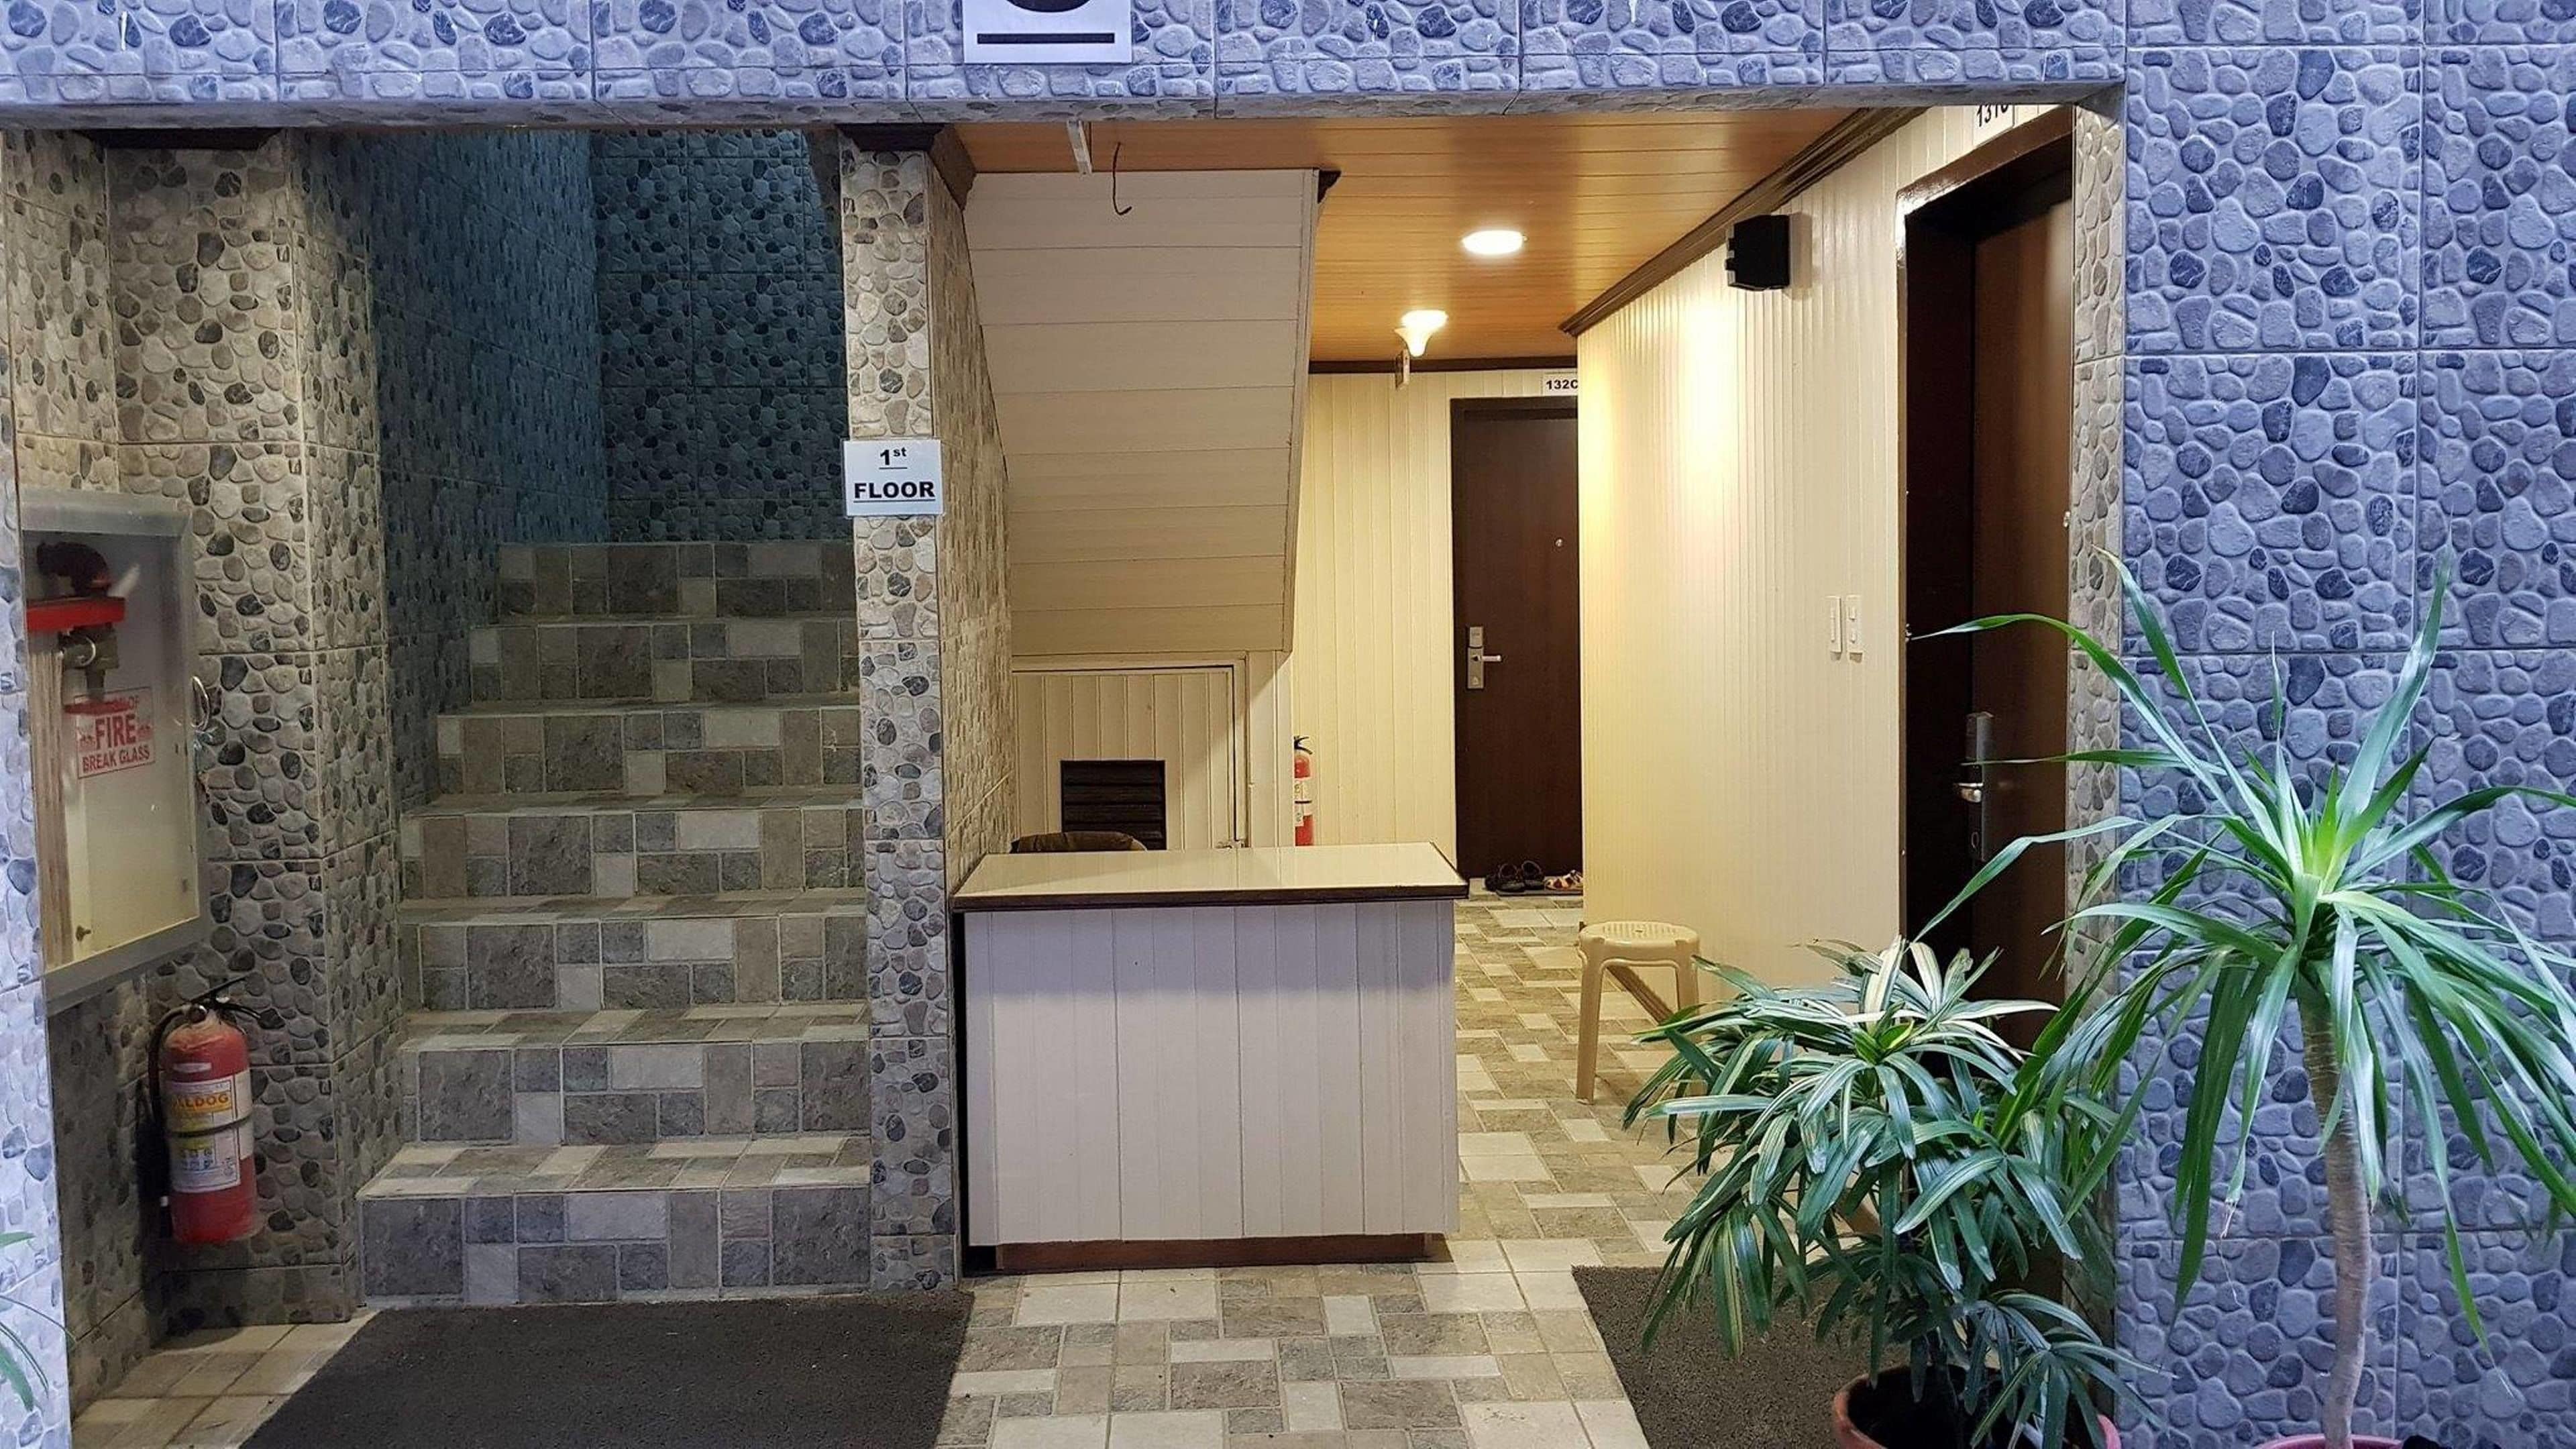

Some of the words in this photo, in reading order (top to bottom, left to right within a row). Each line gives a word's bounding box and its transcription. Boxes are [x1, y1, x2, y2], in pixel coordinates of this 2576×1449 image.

[1546, 379, 1578, 390] 132C
[880, 447, 907, 466] 1st
[854, 482, 935, 498] FLOOR
[95, 714, 137, 749] FIRE
[82, 751, 117, 773] BREAK
[119, 745, 150, 763] GLASS
